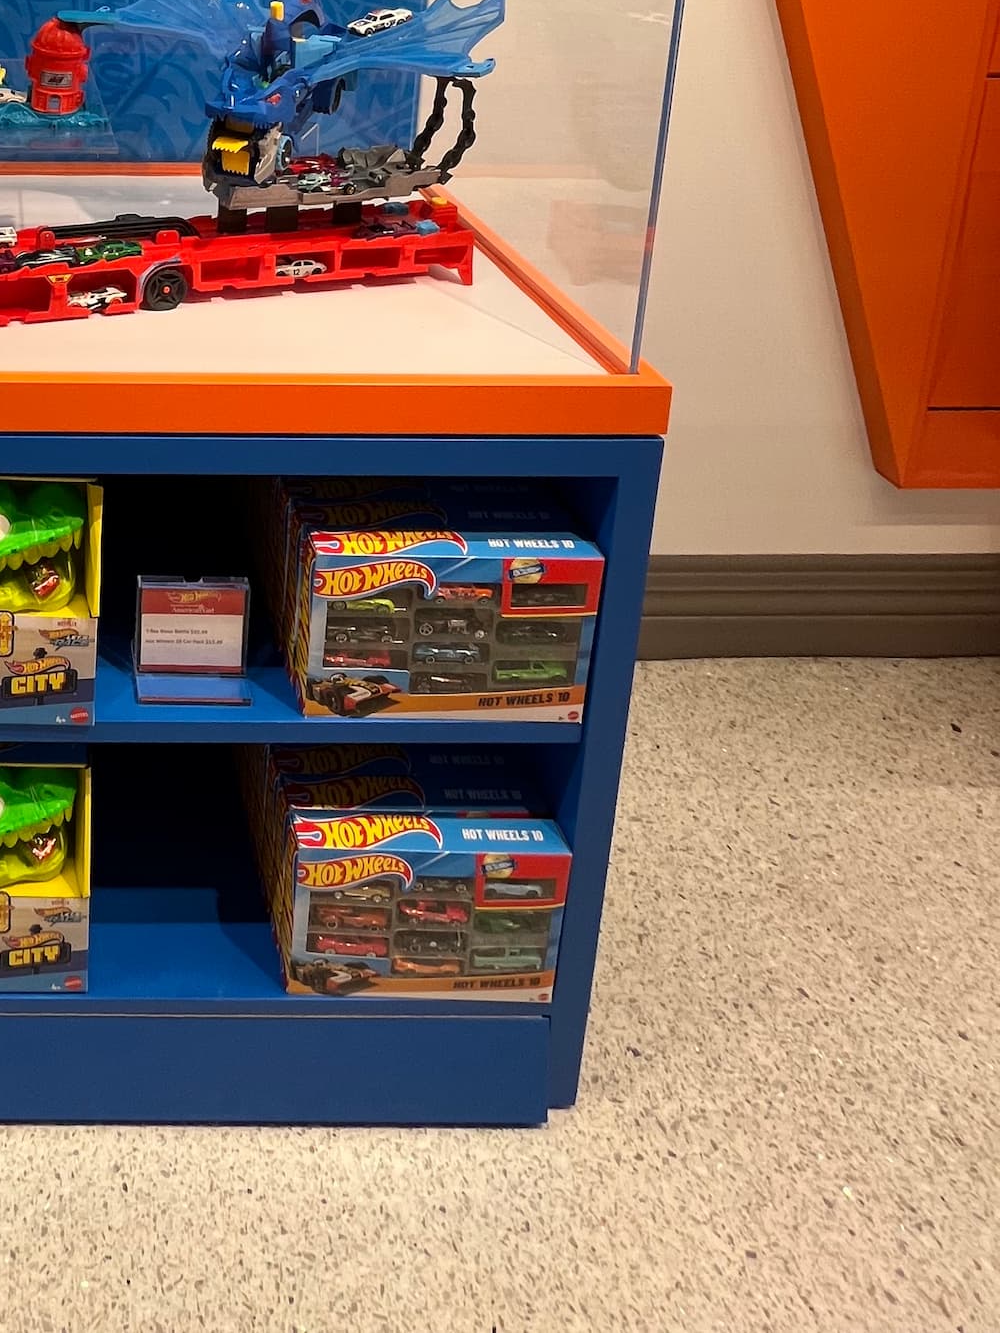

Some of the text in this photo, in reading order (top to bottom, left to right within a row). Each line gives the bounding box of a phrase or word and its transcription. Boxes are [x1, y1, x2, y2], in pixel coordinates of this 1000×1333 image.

[487, 538, 575, 548] HOT WHEELS 10
[10, 672, 65, 695] CITY
[478, 691, 570, 707] HOT WHEELS 10
[462, 828, 544, 842] HOT WHEELS 10
[8, 945, 60, 966] CITY
